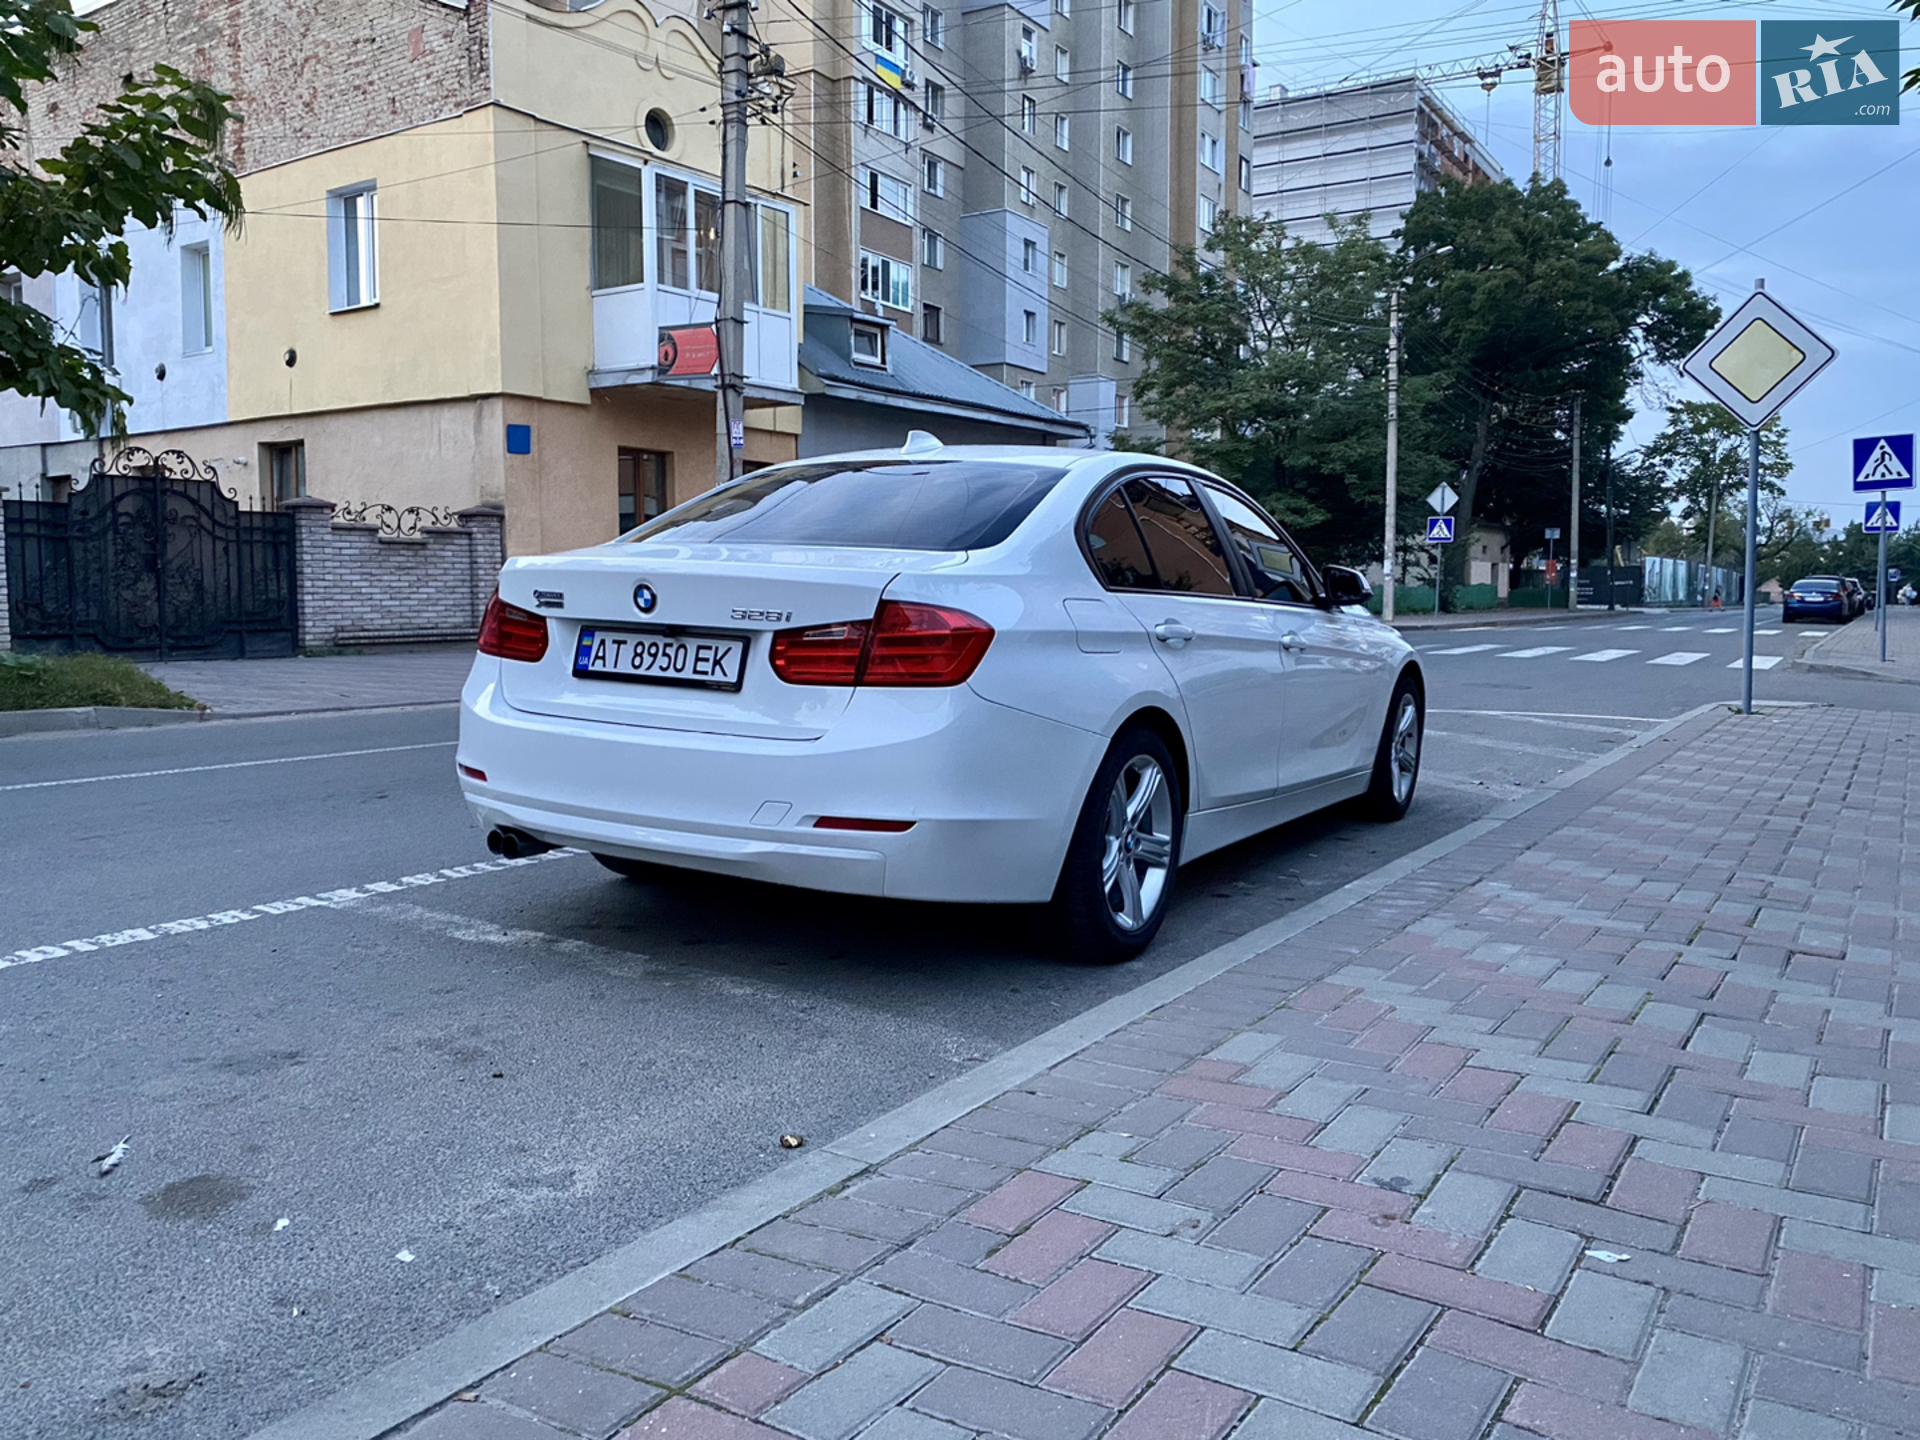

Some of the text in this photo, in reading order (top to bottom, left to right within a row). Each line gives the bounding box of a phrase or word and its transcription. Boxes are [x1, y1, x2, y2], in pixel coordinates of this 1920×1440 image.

[578, 655, 589, 665] UA
[591, 638, 733, 678] AT 8950 EK
